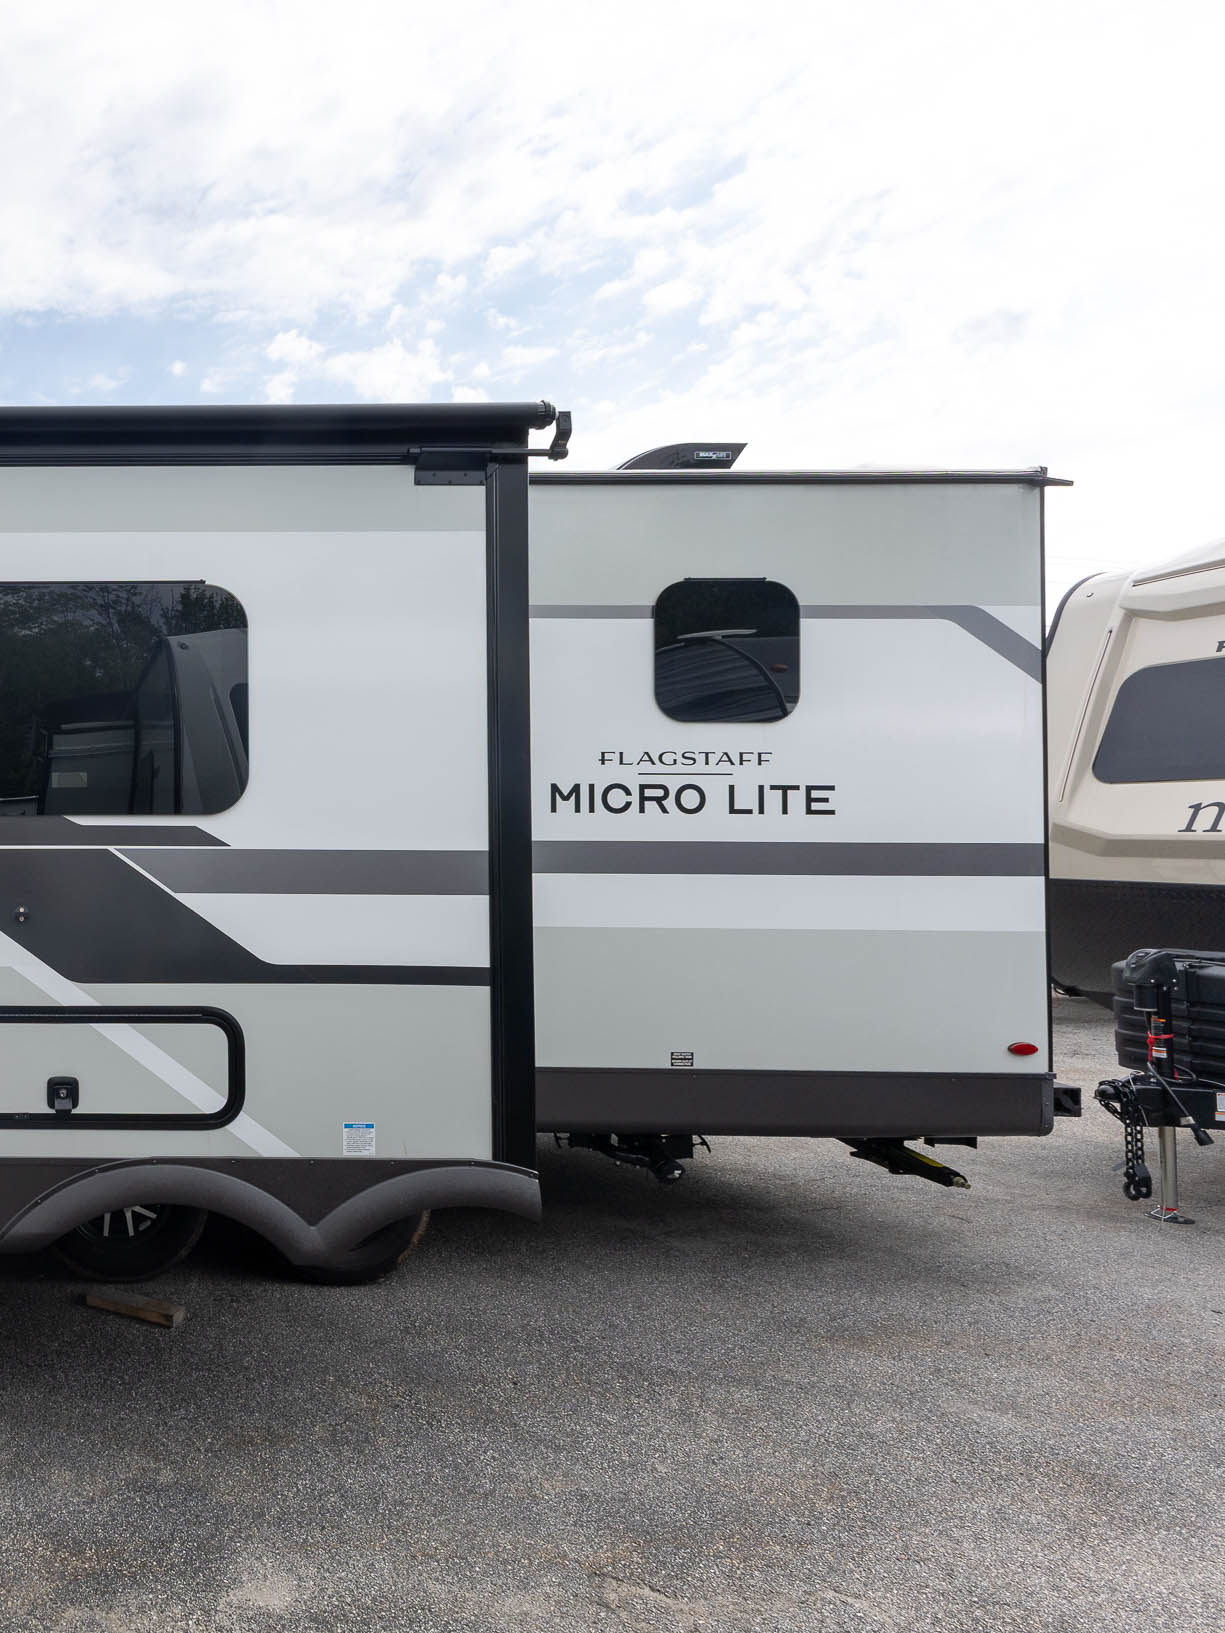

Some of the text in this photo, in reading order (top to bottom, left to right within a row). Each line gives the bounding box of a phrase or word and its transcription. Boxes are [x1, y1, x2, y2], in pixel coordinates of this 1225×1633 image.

[597, 750, 773, 766] FLAGSTAFF
[549, 782, 837, 816] MICRO LITE
